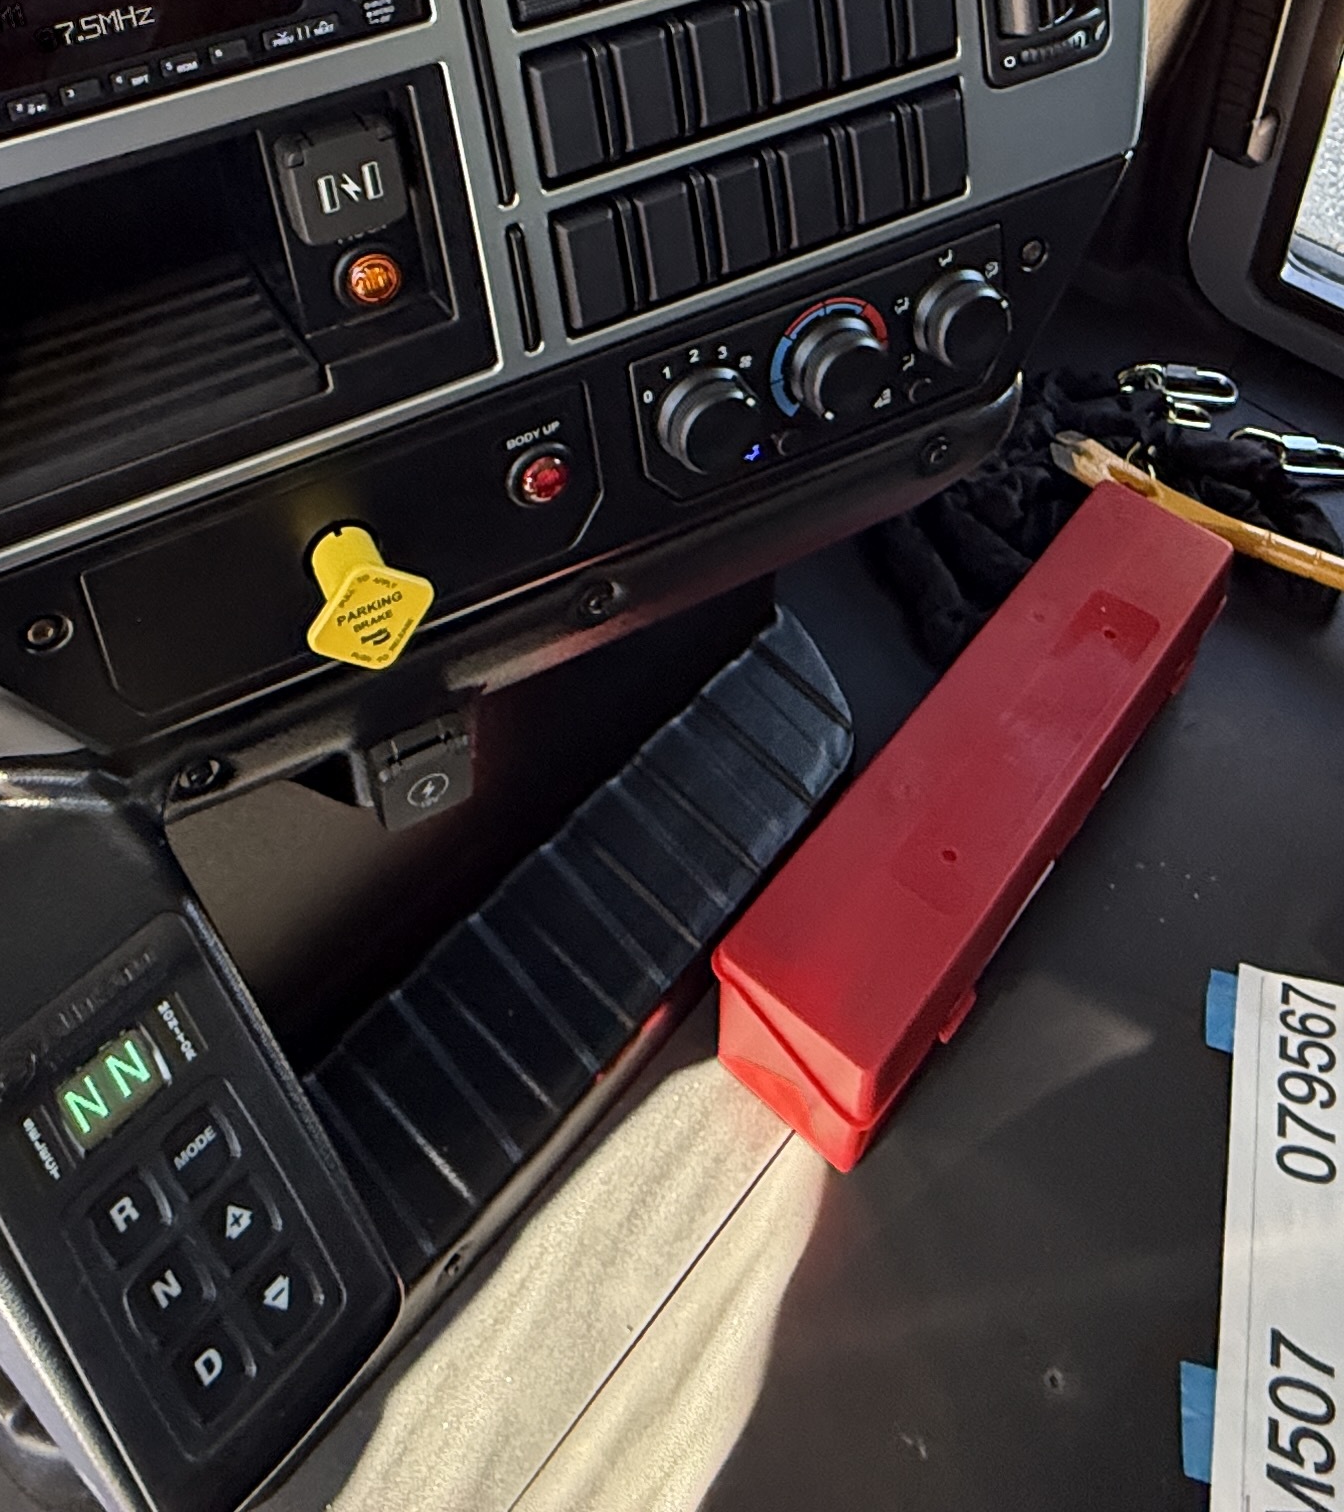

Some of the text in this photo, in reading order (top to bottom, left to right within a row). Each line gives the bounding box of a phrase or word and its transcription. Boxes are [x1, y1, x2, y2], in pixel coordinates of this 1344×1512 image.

[642, 345, 728, 404] 0 1 2 3
[505, 420, 561, 451] BODY UP
[336, 590, 404, 628] PARKING
[352, 609, 394, 633] BRAKE
[156, 999, 199, 1063] MONITOR
[1274, 981, 1338, 1185] 079567
[172, 1124, 218, 1172] MODE
[109, 1195, 140, 1233] R
[151, 1268, 183, 1310] N
[193, 1347, 223, 1388] D
